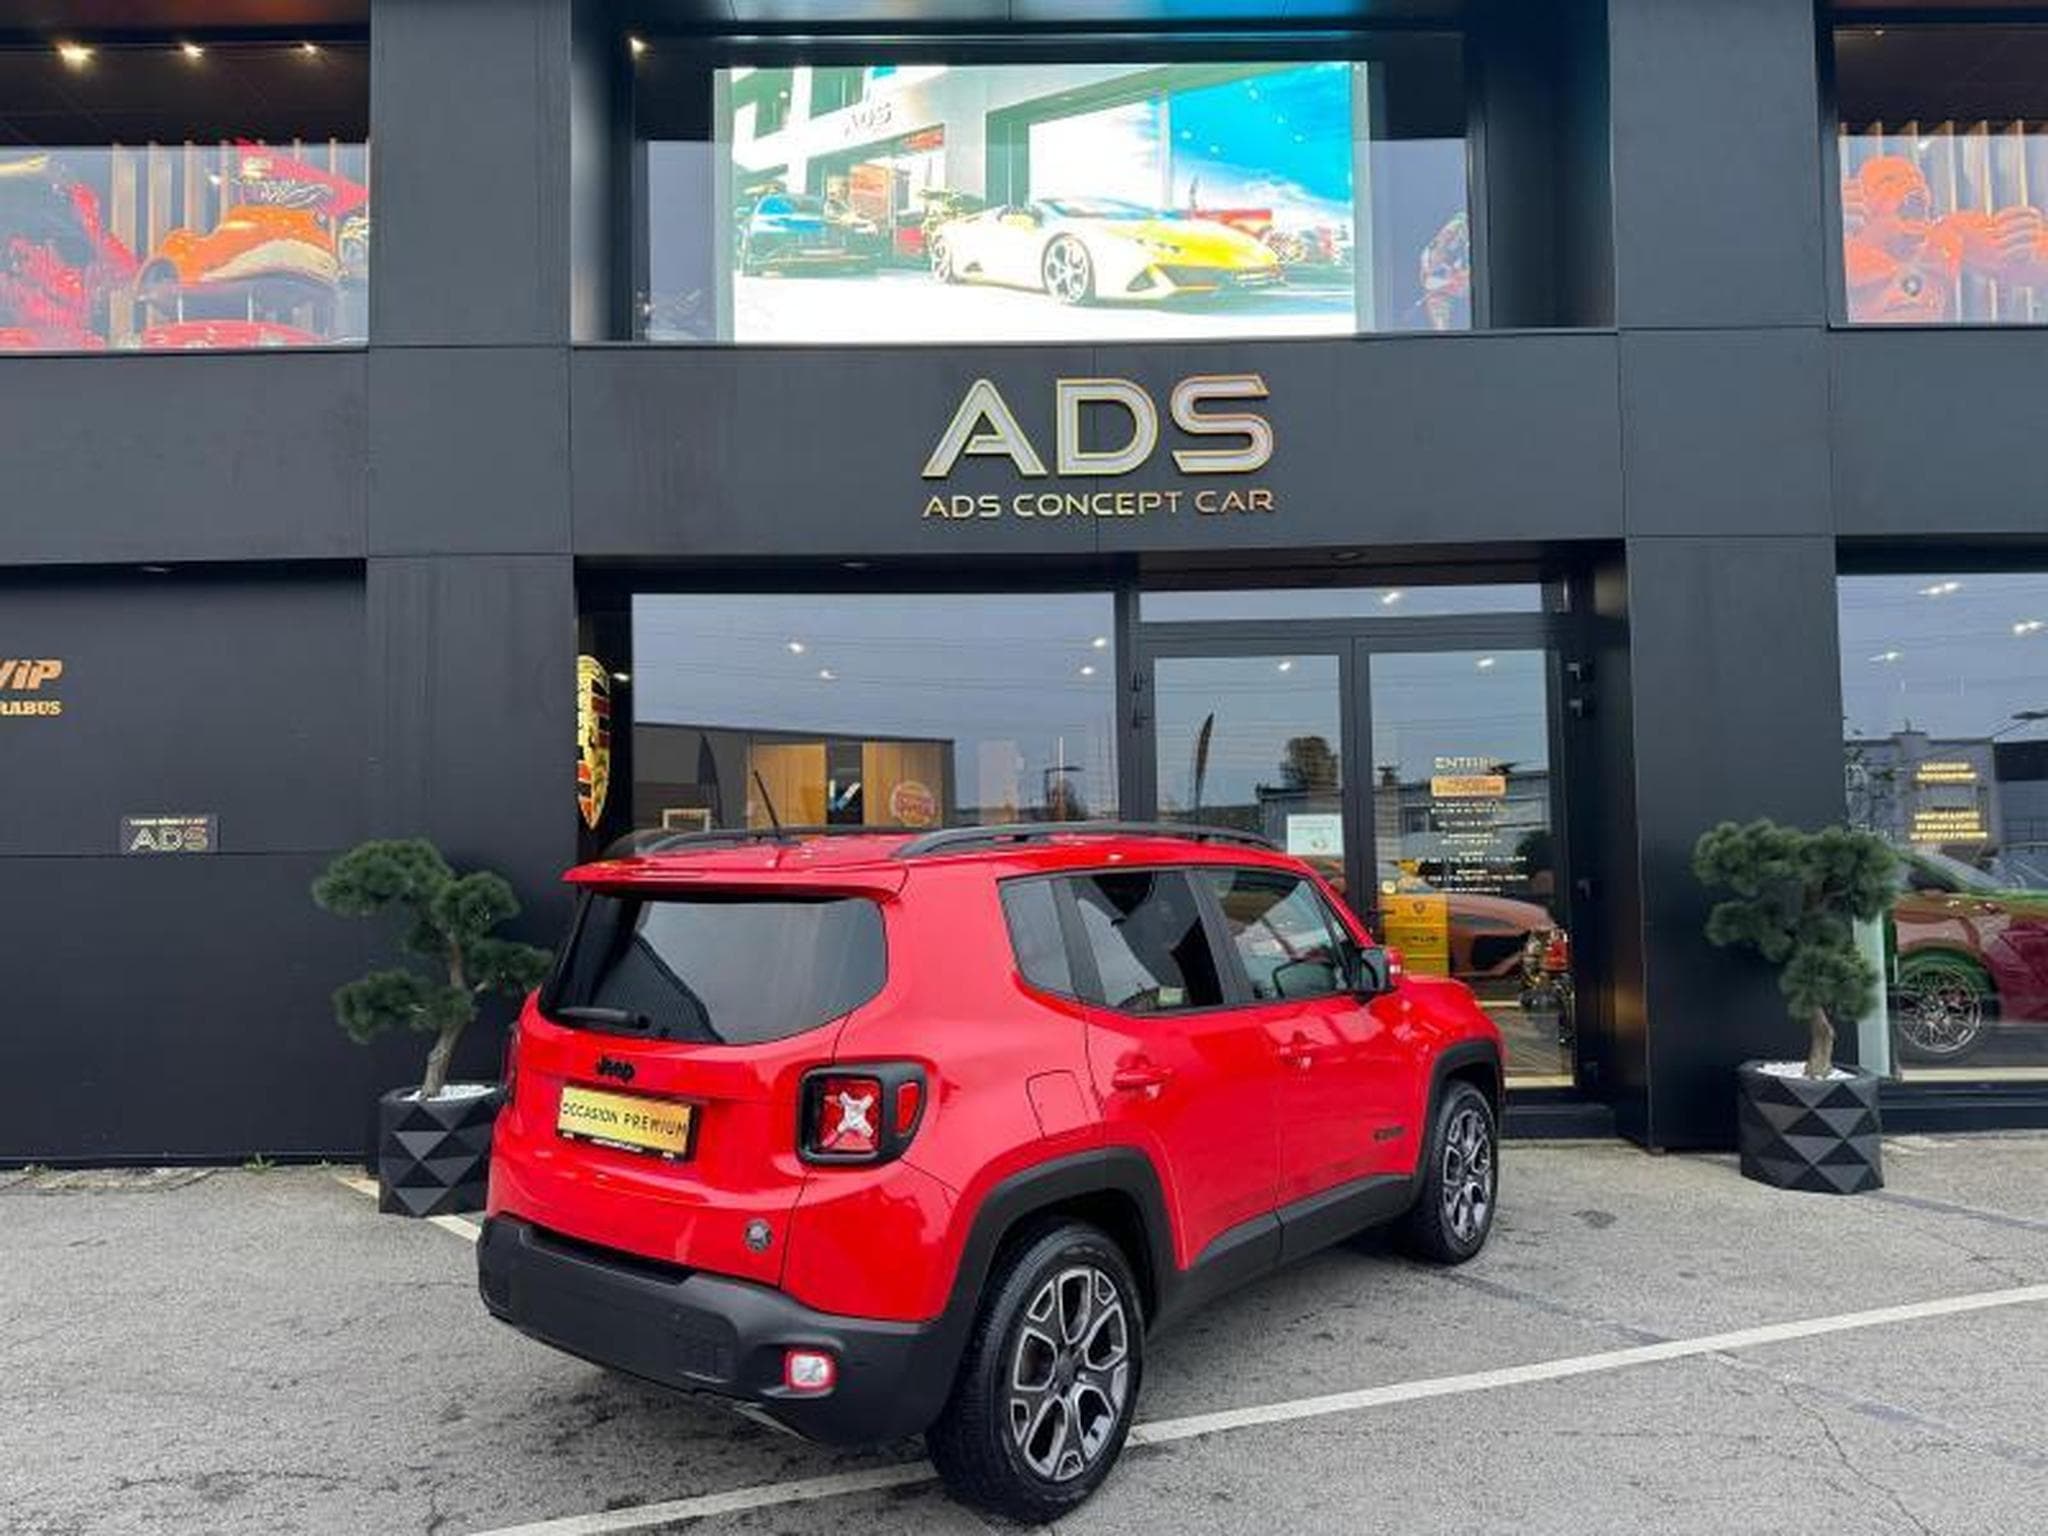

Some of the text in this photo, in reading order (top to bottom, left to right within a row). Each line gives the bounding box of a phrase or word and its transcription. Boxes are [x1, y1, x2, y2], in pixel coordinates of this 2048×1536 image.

[921, 375, 1275, 478] ADS
[922, 489, 1275, 519] ADS CONCEPT CAR
[130, 827, 208, 851] ADS
[562, 1102, 688, 1137] OCCASION PREMIUM
